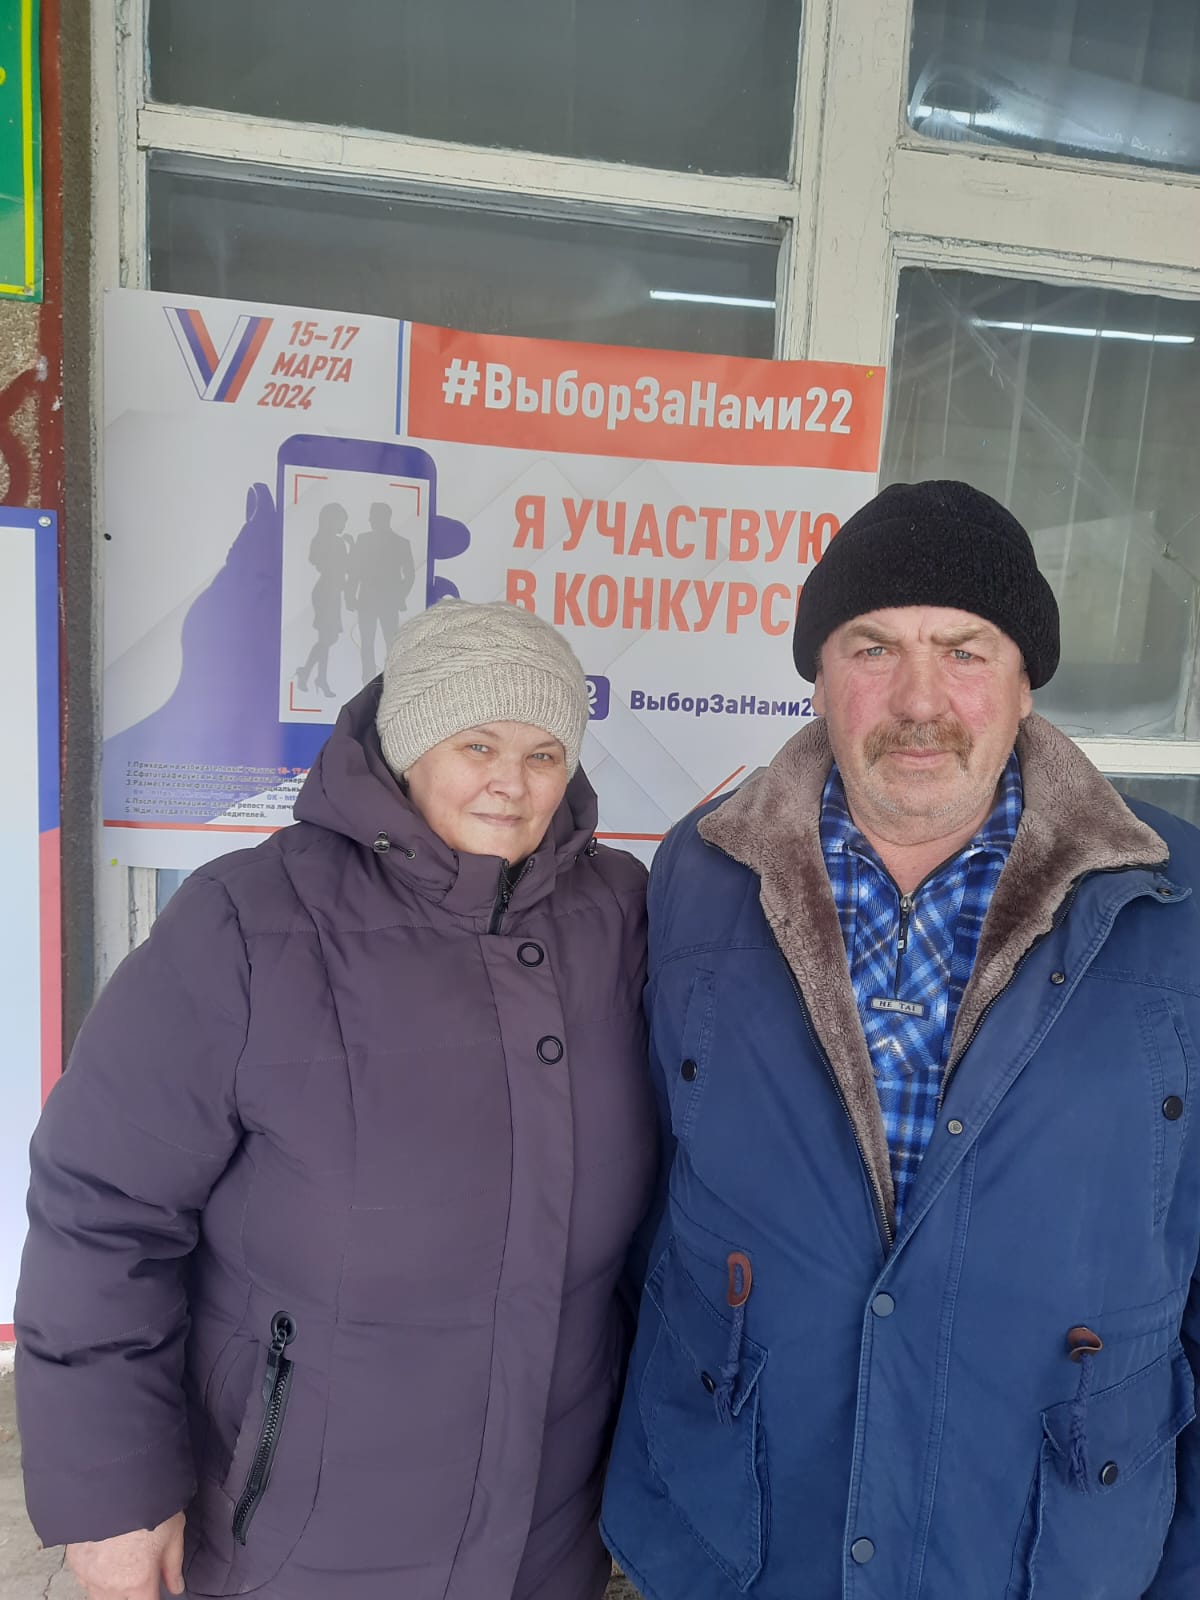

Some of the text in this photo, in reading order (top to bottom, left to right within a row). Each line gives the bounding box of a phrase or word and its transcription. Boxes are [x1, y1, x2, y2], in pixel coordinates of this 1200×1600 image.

[271, 351, 353, 383] МАРТА
[256, 382, 317, 411] 2024
[441, 357, 854, 435] #ВыборЗаНами22
[512, 494, 842, 565] Я УЧАСТВУЮ
[505, 567, 804, 637] В КОНКУРС
[630, 689, 821, 718] ВыборЗаНами2
